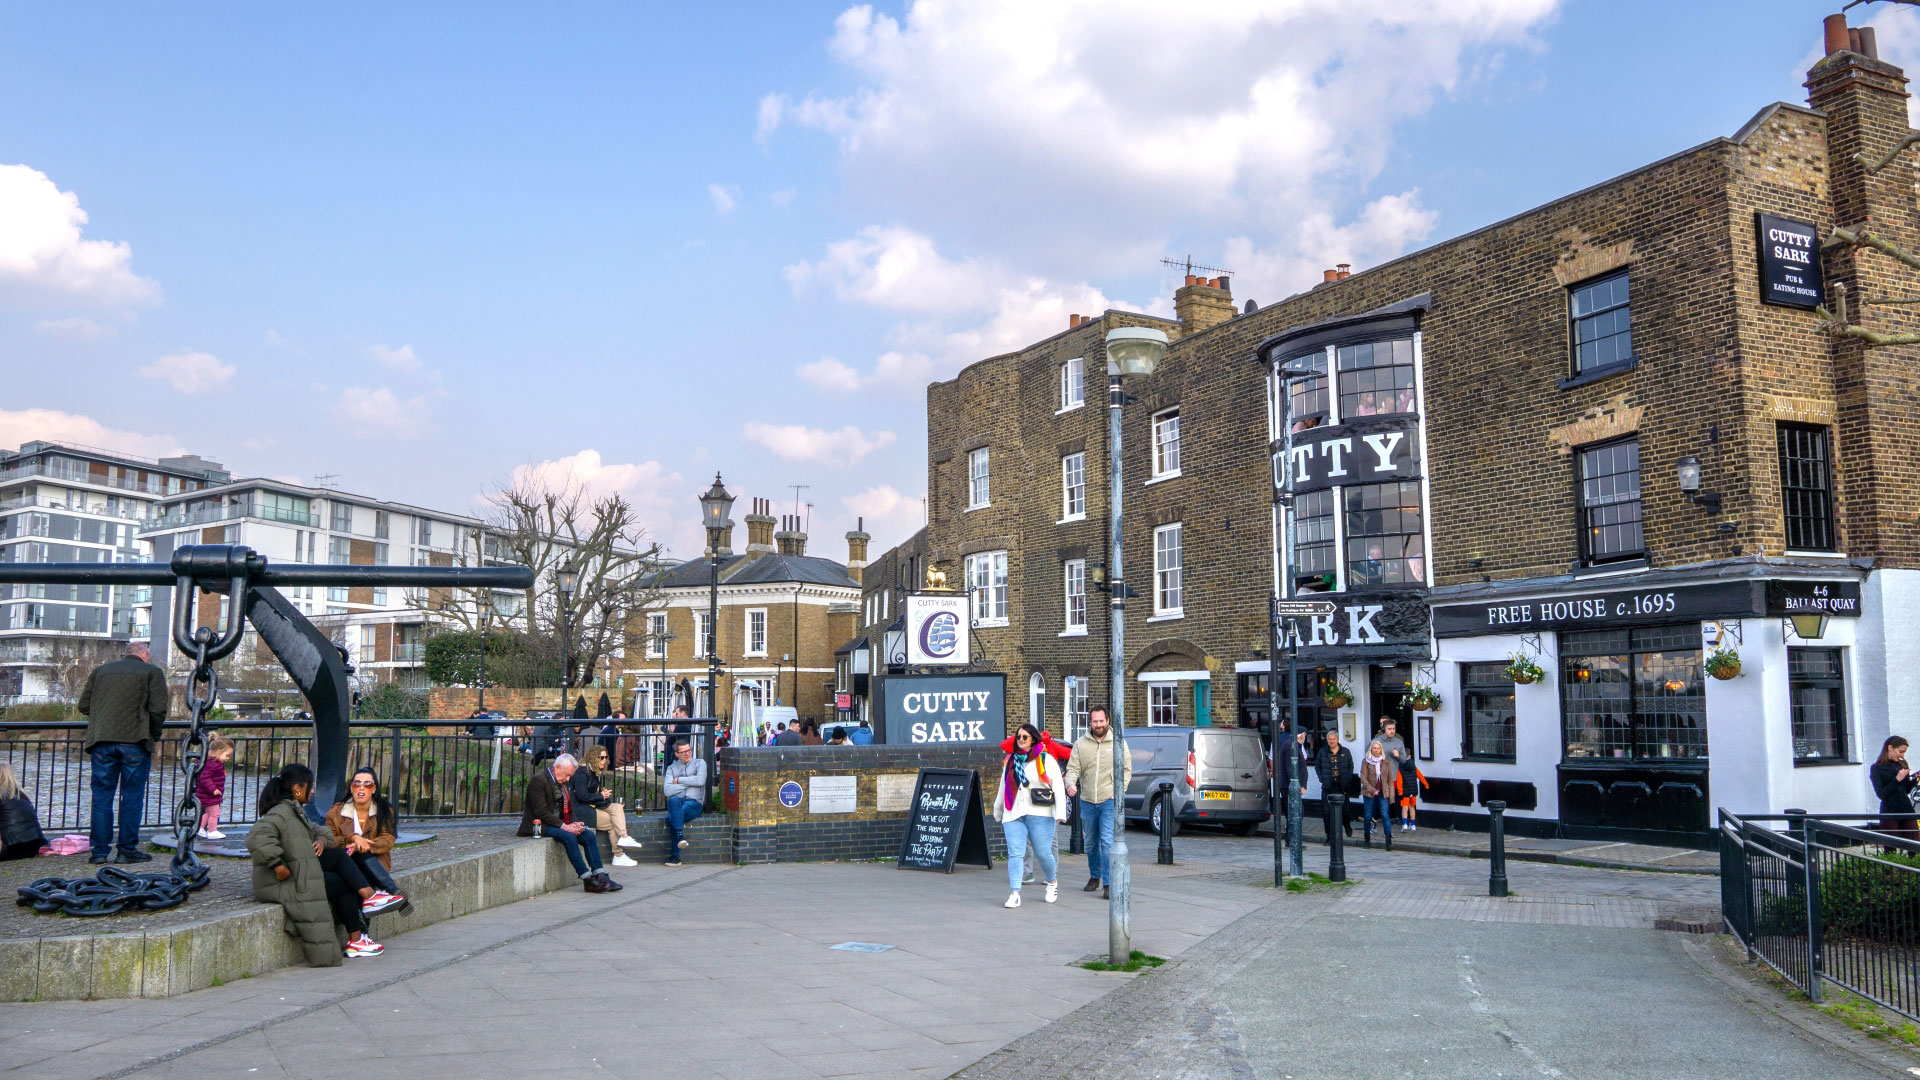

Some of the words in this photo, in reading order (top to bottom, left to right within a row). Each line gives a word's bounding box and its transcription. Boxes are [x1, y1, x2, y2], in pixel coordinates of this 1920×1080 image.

[1769, 228, 1812, 248] CUTTY
[1774, 246, 1811, 264] SARK
[1785, 274, 1798, 283] PUB
[1773, 283, 1796, 294] EATING
[1796, 286, 1818, 297] HOUSE
[1813, 585, 1829, 597] 4-6
[917, 599, 940, 607] CUTTY
[941, 599, 958, 607] SARK
[1487, 605, 1532, 625] FREE
[1539, 599, 1607, 621] HOUSE
[1616, 592, 1676, 616] c.1695
[1785, 597, 1828, 609] BALLAST
[1830, 599, 1856, 612] QUAY
[903, 691, 990, 714] CUTTY
[911, 720, 985, 744] SARK
[938, 815, 950, 823] GOT
[916, 824, 928, 832] THE
[920, 833, 929, 842] YOU
